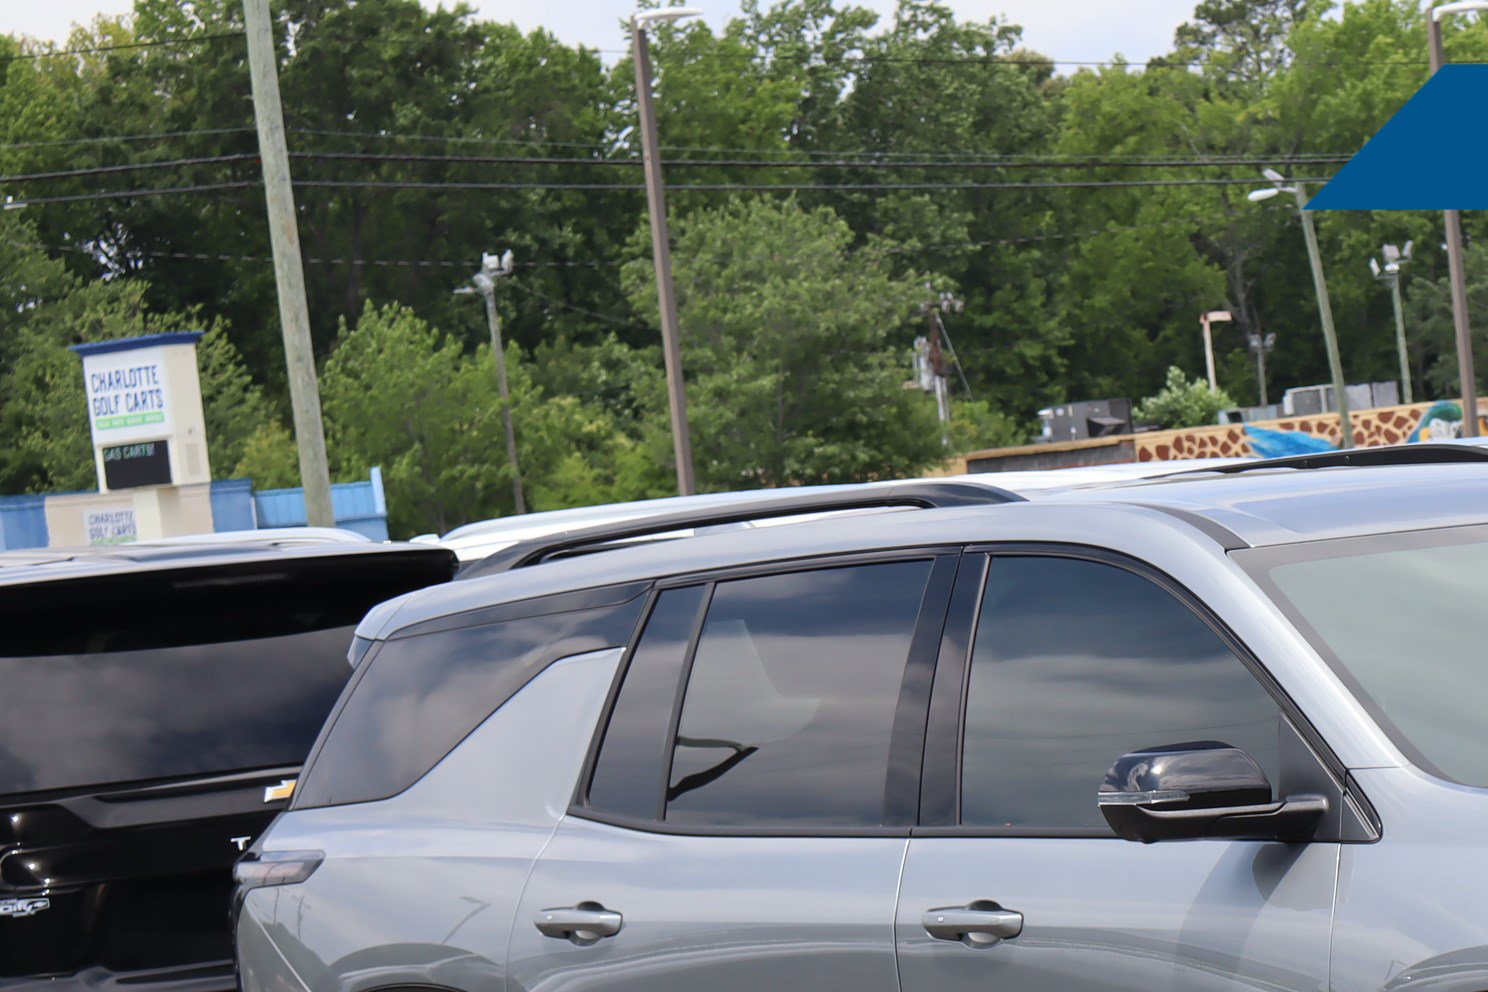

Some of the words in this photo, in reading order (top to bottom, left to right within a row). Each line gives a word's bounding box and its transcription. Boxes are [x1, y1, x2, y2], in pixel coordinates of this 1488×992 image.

[91, 365, 159, 393] CHARLOTTE
[93, 395, 119, 416] GOLF
[125, 388, 163, 412] CARTS
[88, 510, 134, 525] CHARLOTTE
[88, 526, 109, 540] GOLF
[111, 523, 138, 537] CARTS
